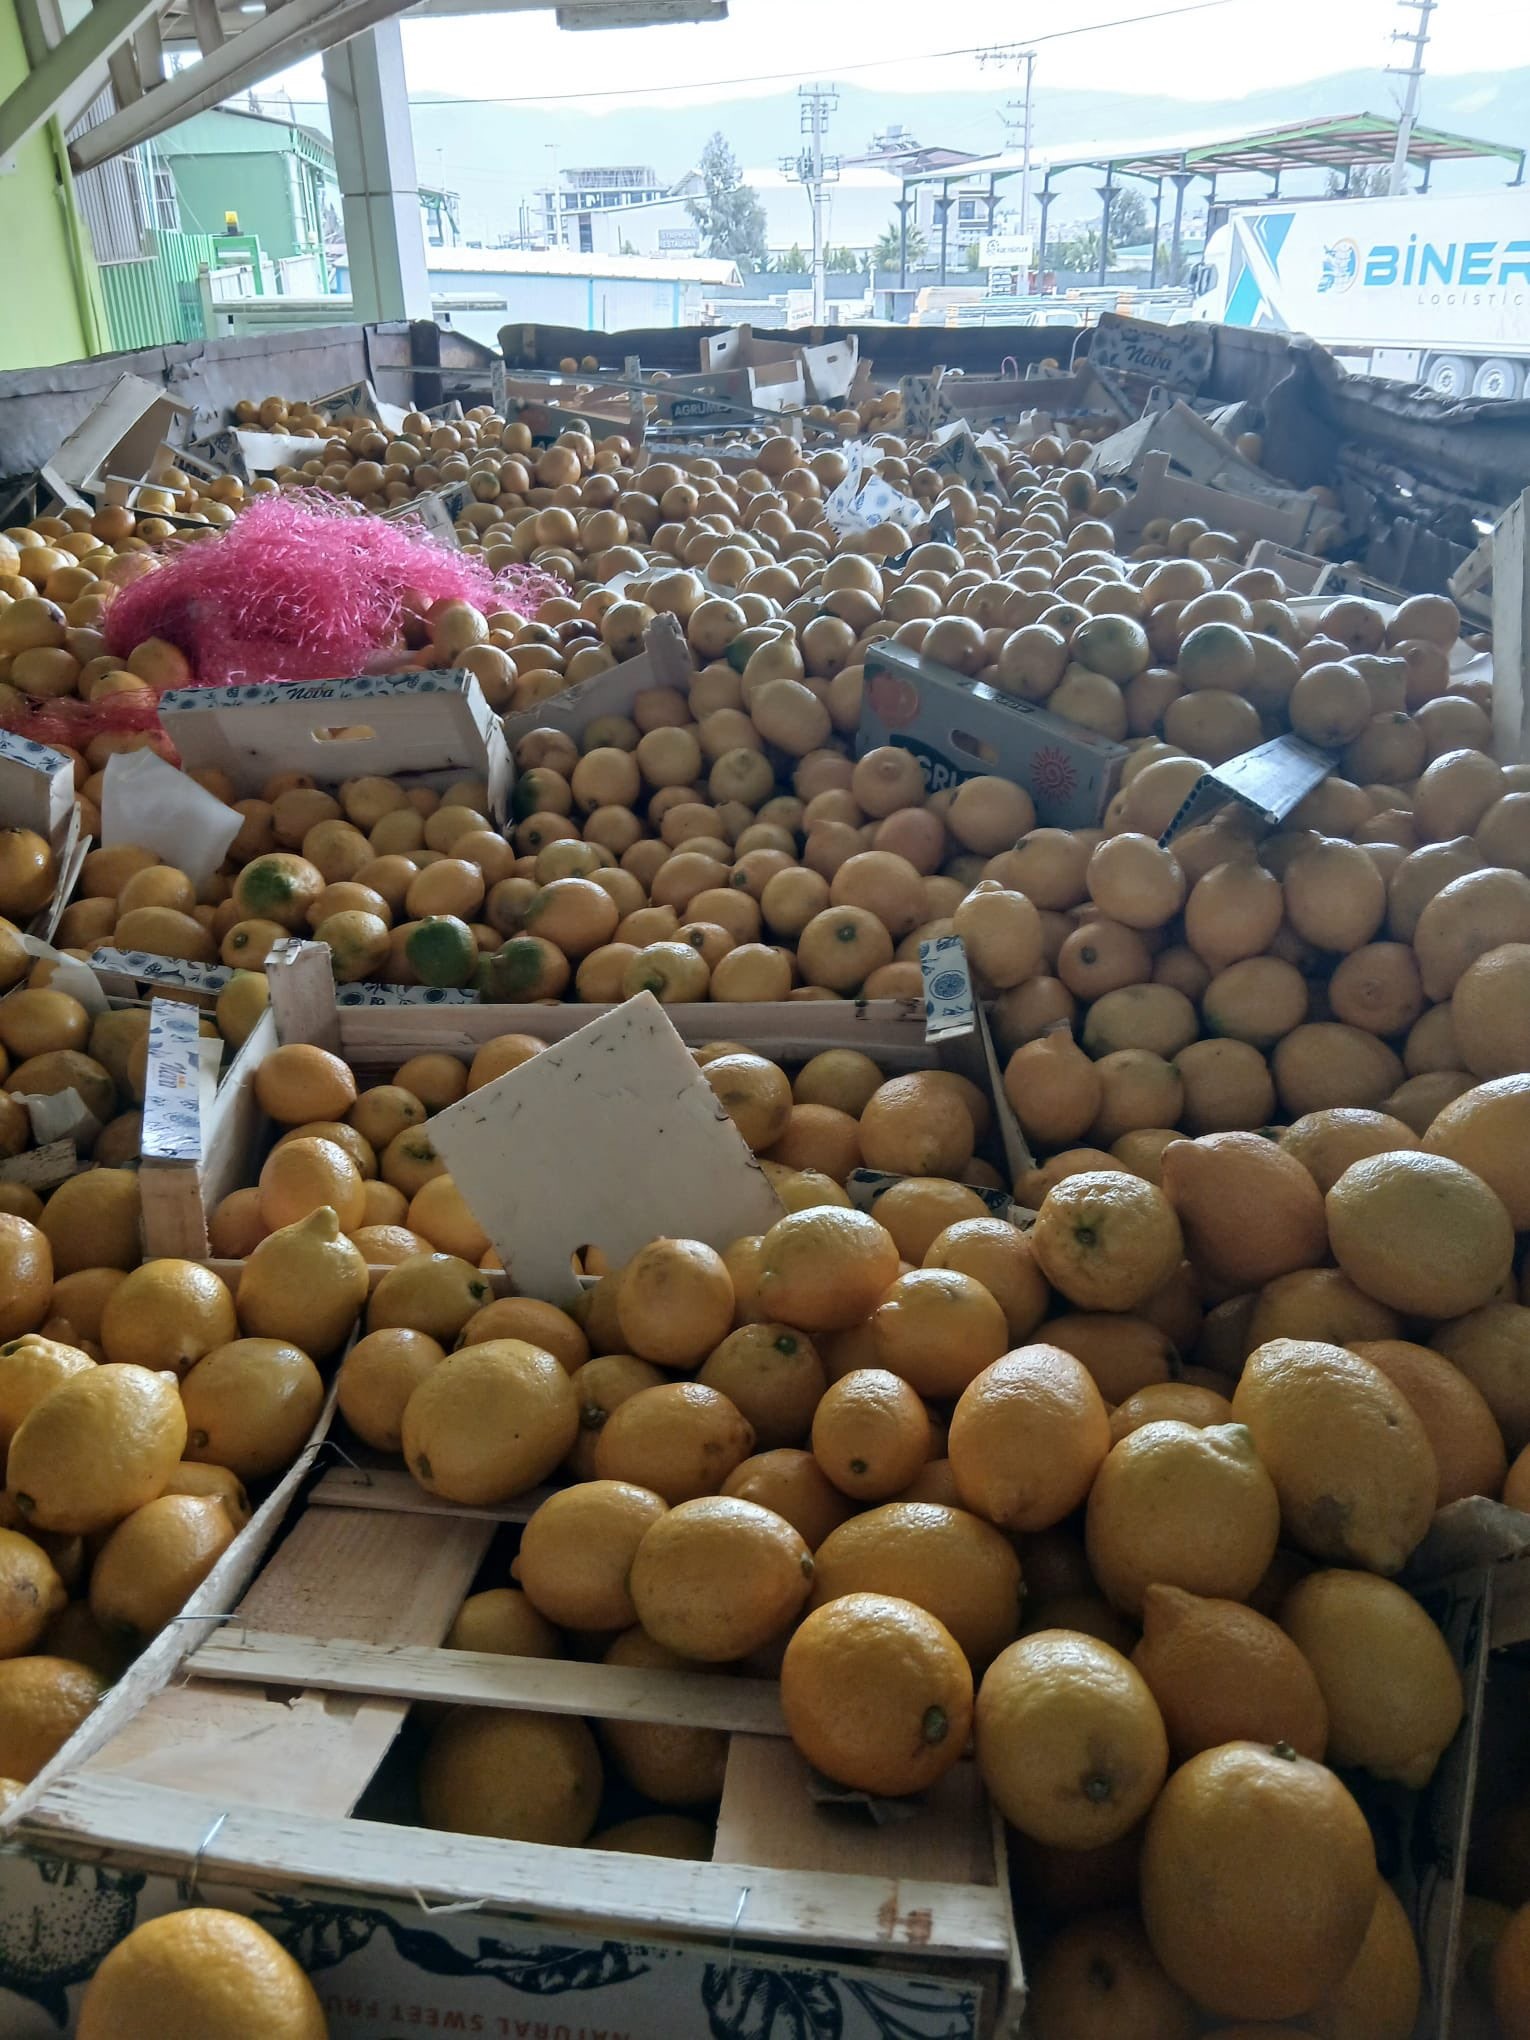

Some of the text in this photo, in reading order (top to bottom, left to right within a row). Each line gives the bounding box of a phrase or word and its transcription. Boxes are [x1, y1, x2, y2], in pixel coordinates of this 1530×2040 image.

[1124, 344, 1172, 371] Nova
[286, 687, 335, 700] Nova
[325, 1996, 378, 2020] FRU
[391, 2003, 484, 2031] SWEET
